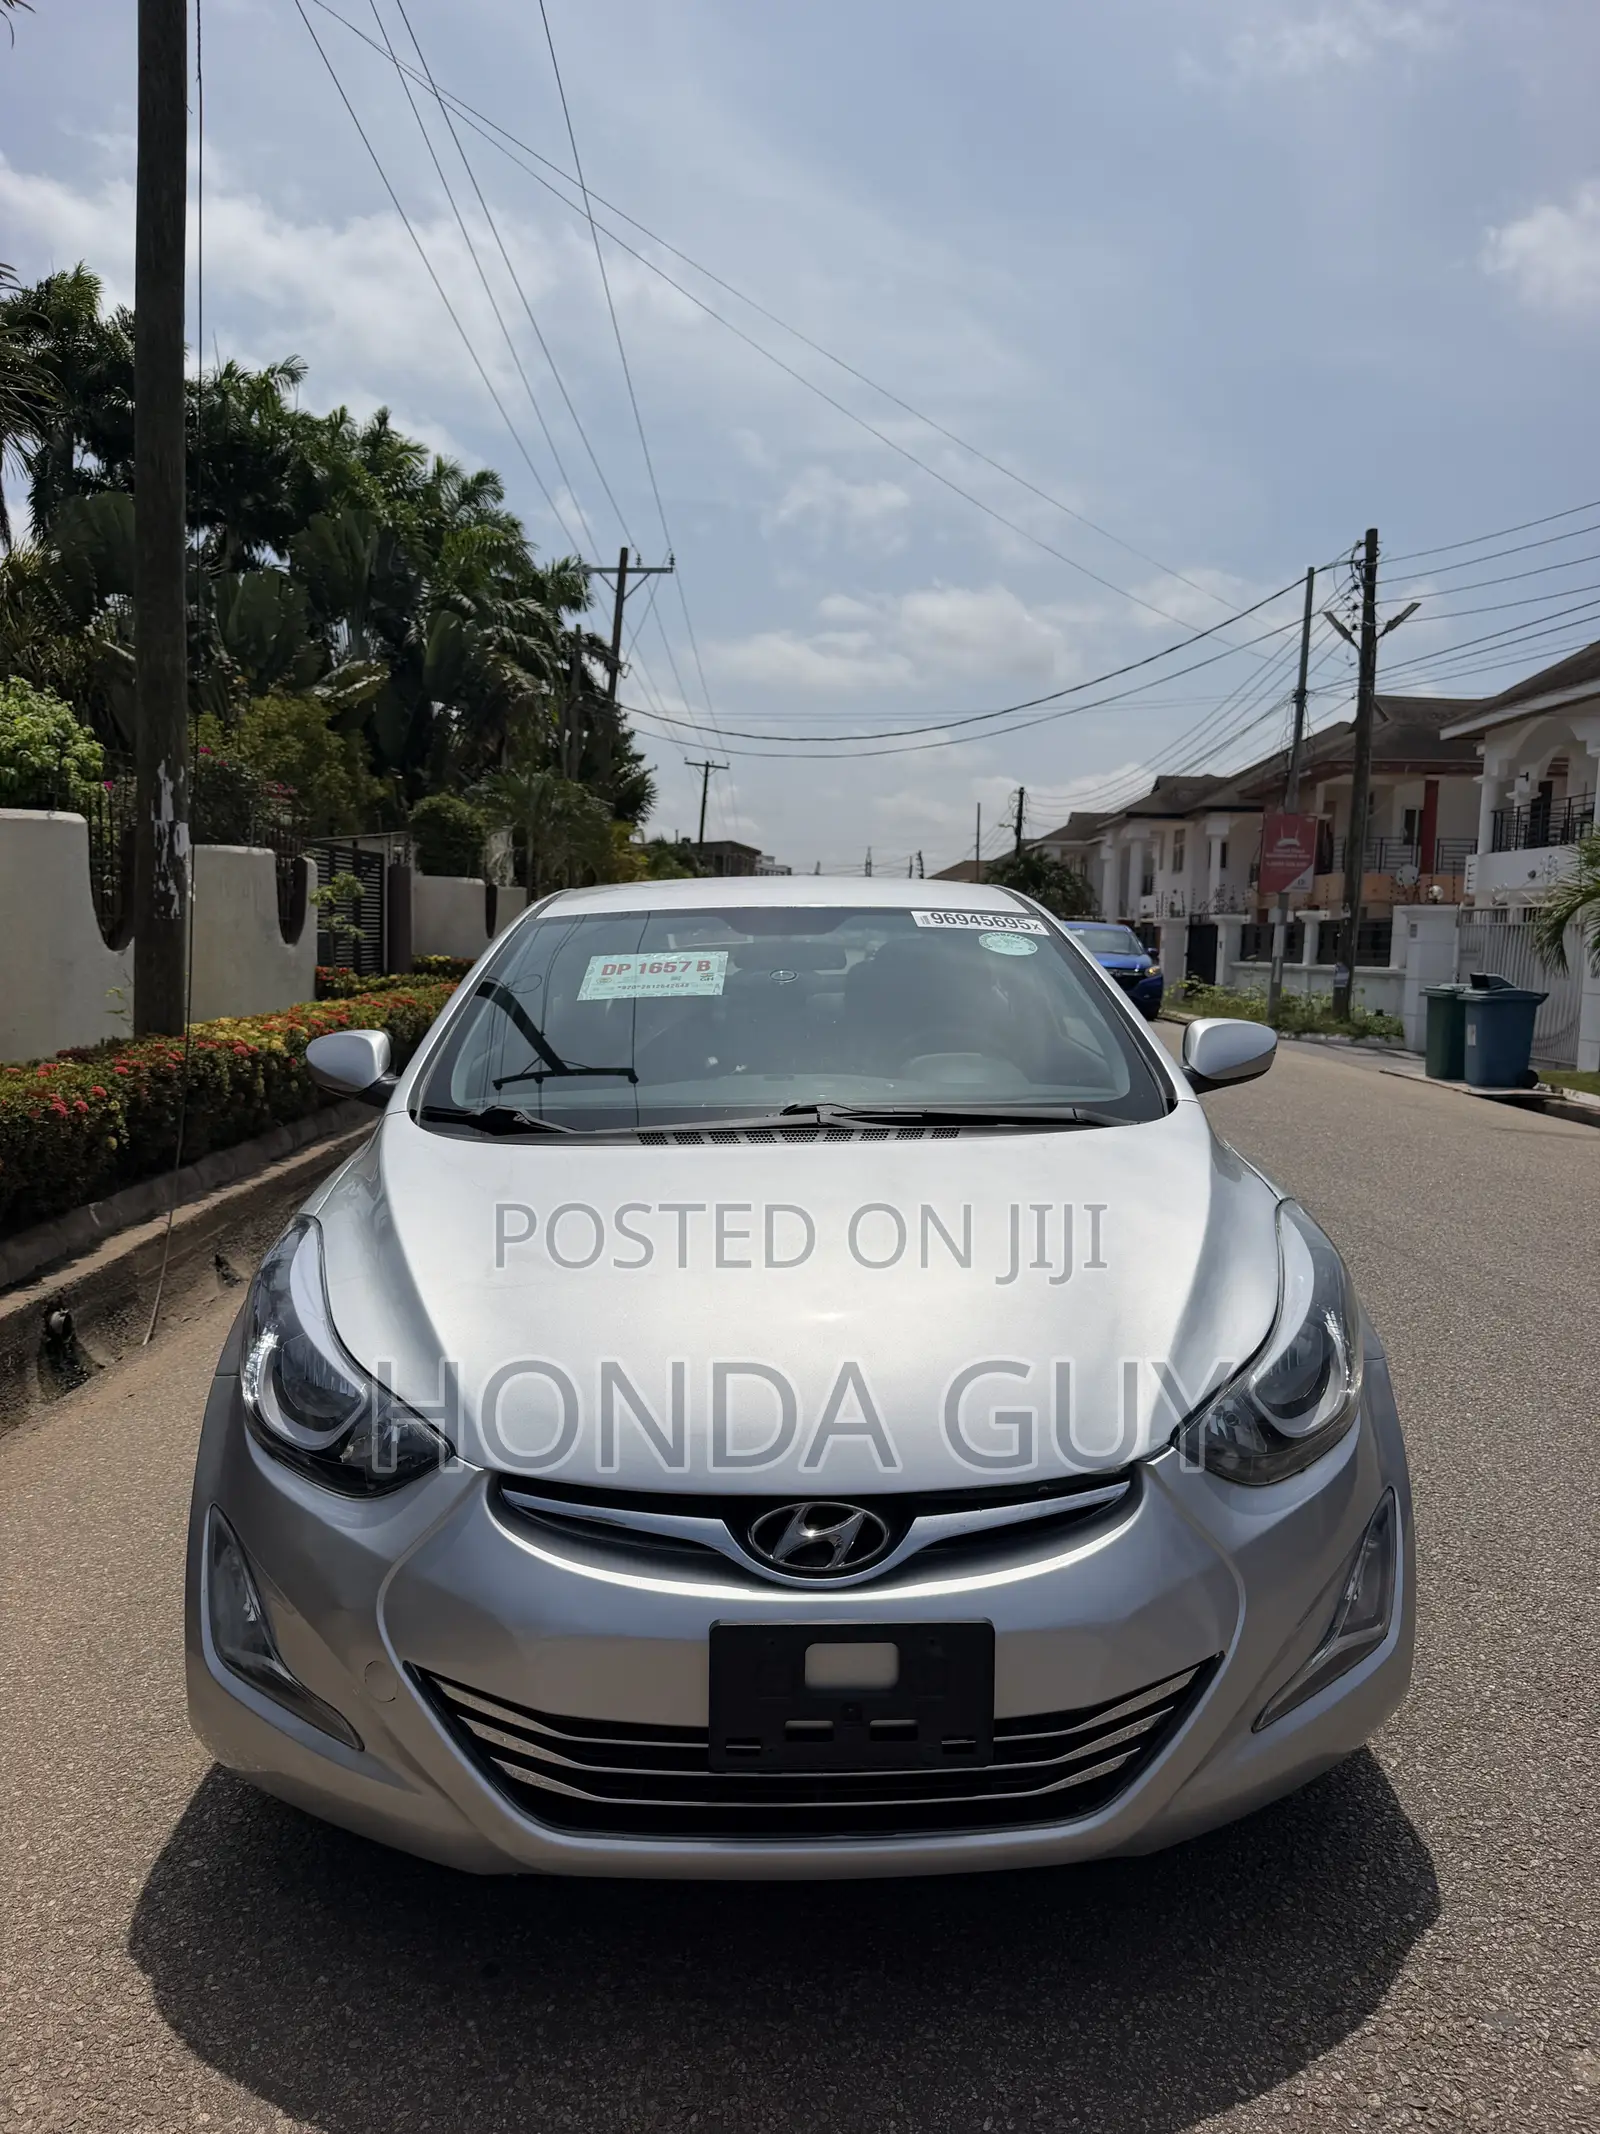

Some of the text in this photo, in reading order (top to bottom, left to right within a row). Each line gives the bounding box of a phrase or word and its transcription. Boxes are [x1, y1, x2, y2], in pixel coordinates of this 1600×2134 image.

[601, 960, 711, 976] DP 1657 B
